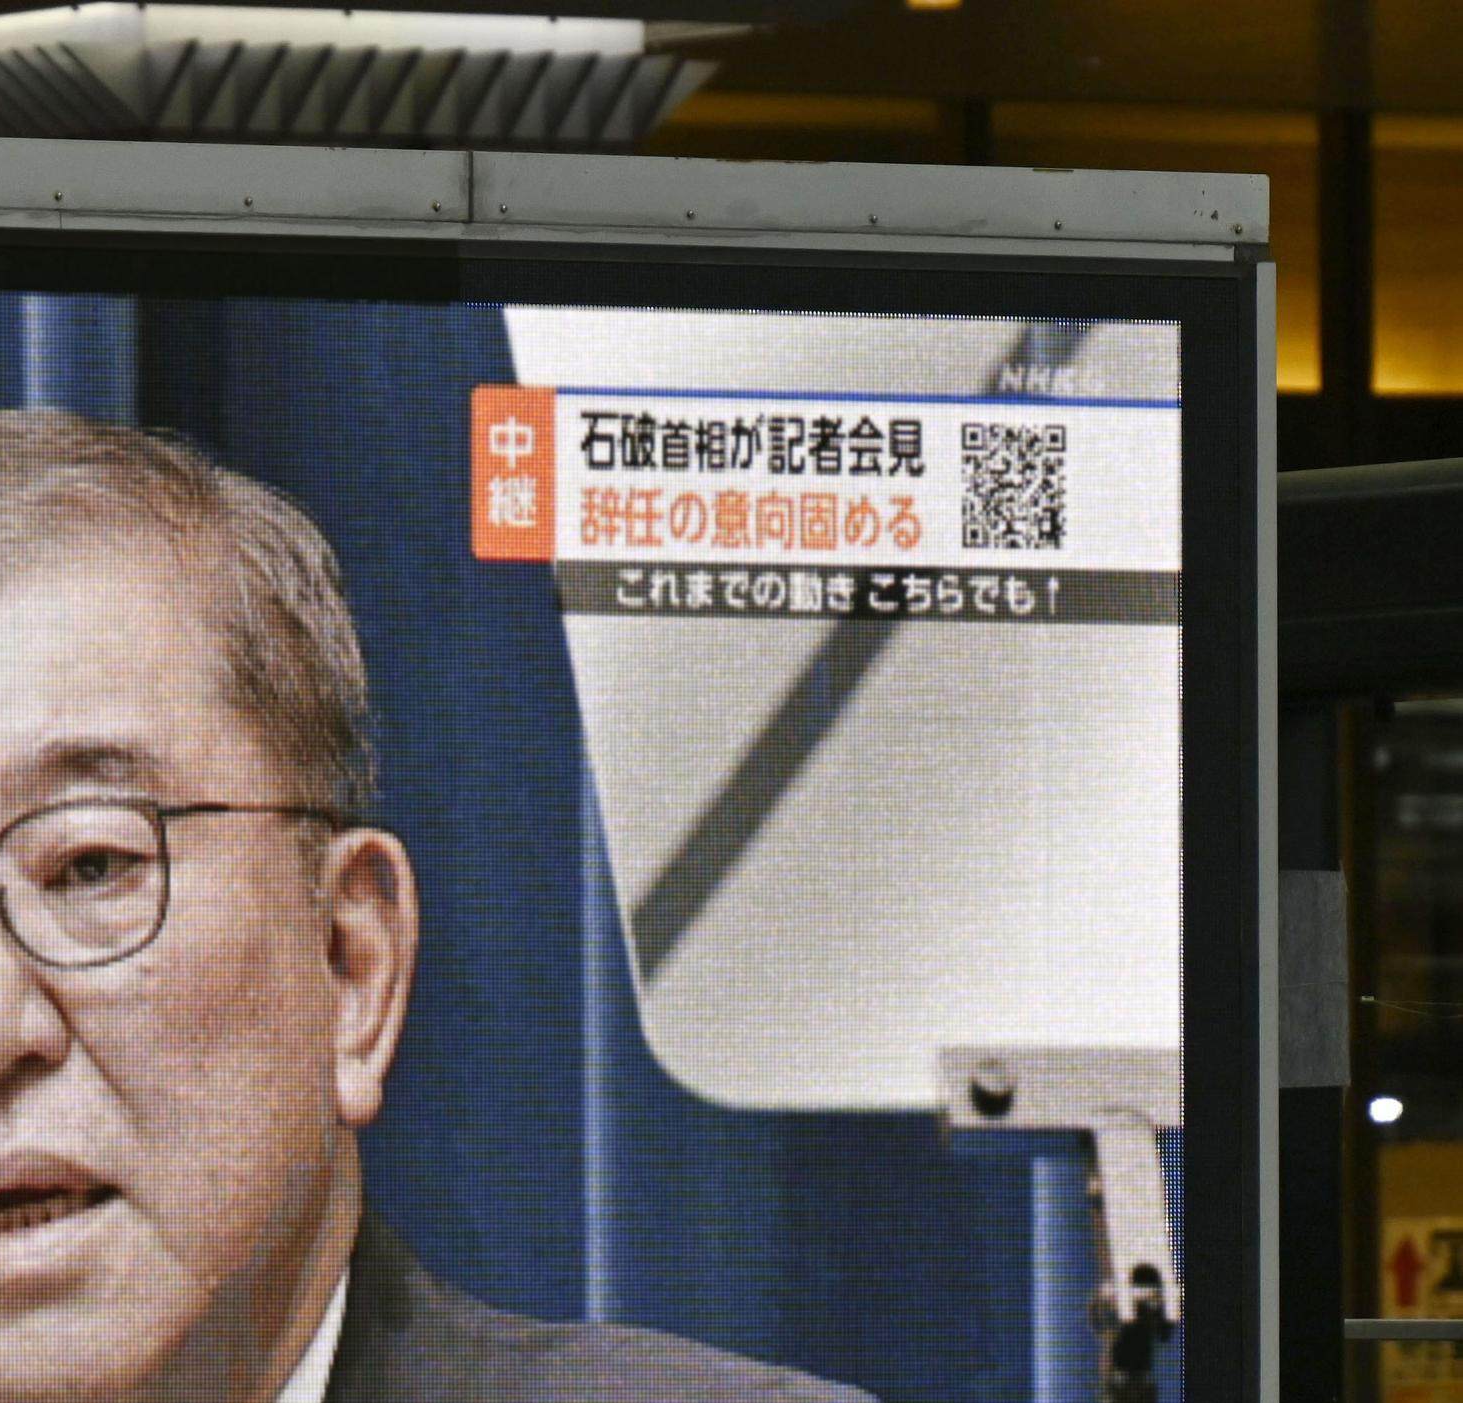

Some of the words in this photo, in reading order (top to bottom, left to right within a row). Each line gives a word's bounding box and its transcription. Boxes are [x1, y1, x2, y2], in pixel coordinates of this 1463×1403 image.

[488, 415, 537, 528] 中継
[580, 410, 925, 477] 石破首相が記者会見
[580, 486, 923, 551] 辞任の意向固める
